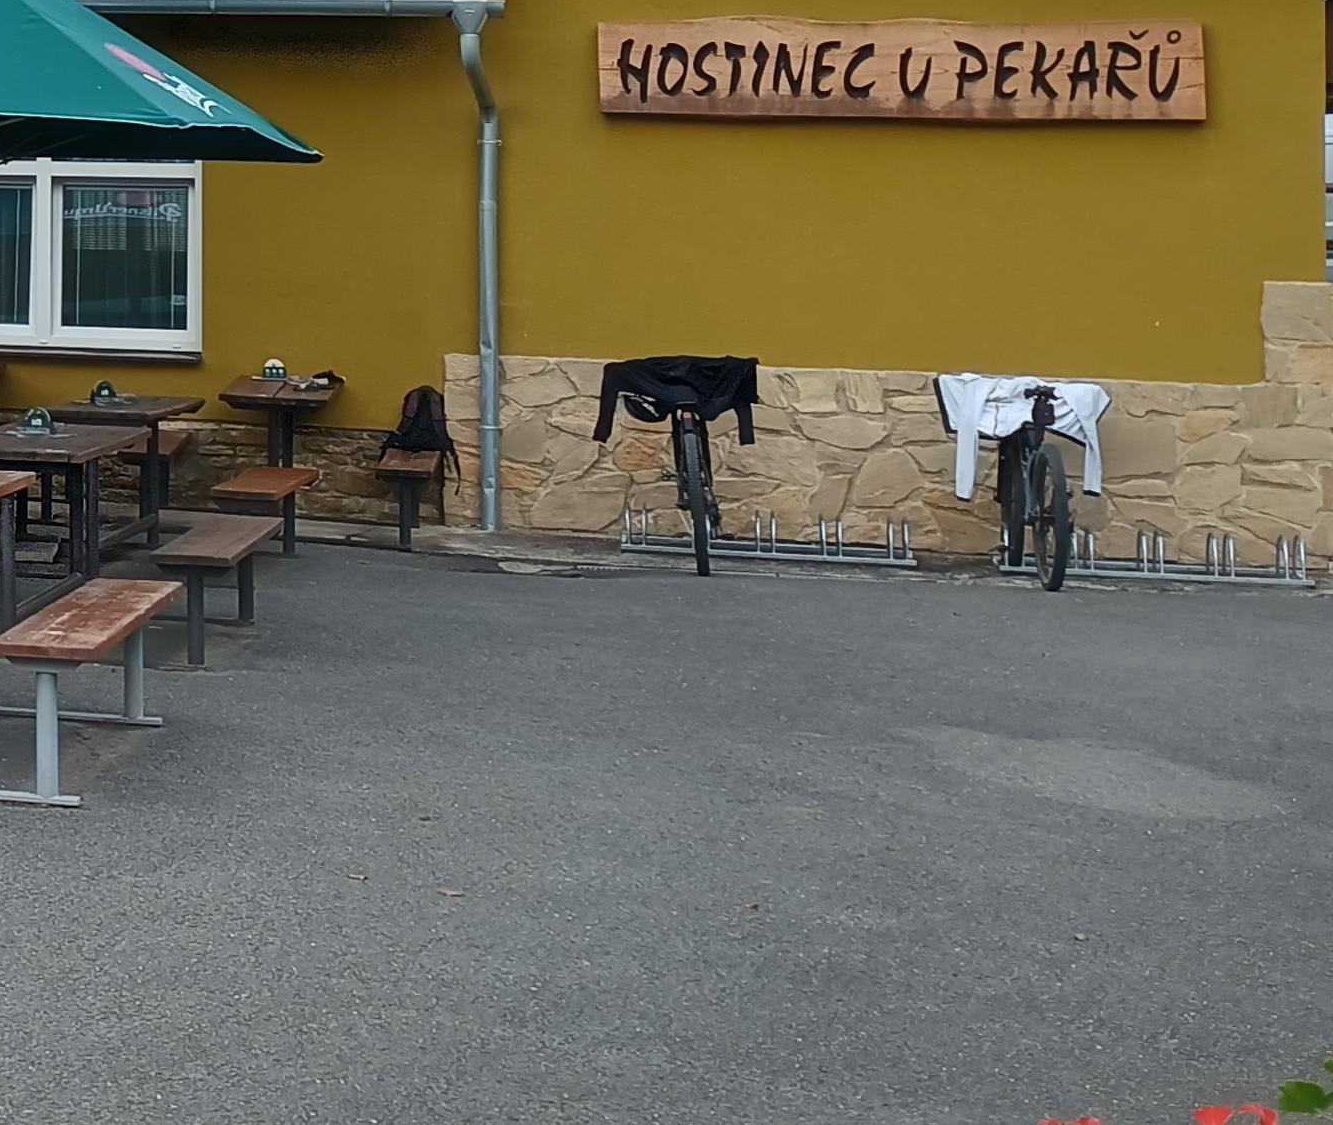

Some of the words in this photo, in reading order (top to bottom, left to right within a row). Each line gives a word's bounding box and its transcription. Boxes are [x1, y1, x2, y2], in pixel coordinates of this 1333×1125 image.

[617, 38, 876, 103] HOSTINEC
[899, 47, 932, 100] U
[954, 29, 1182, 102] PEKAŘŮ
